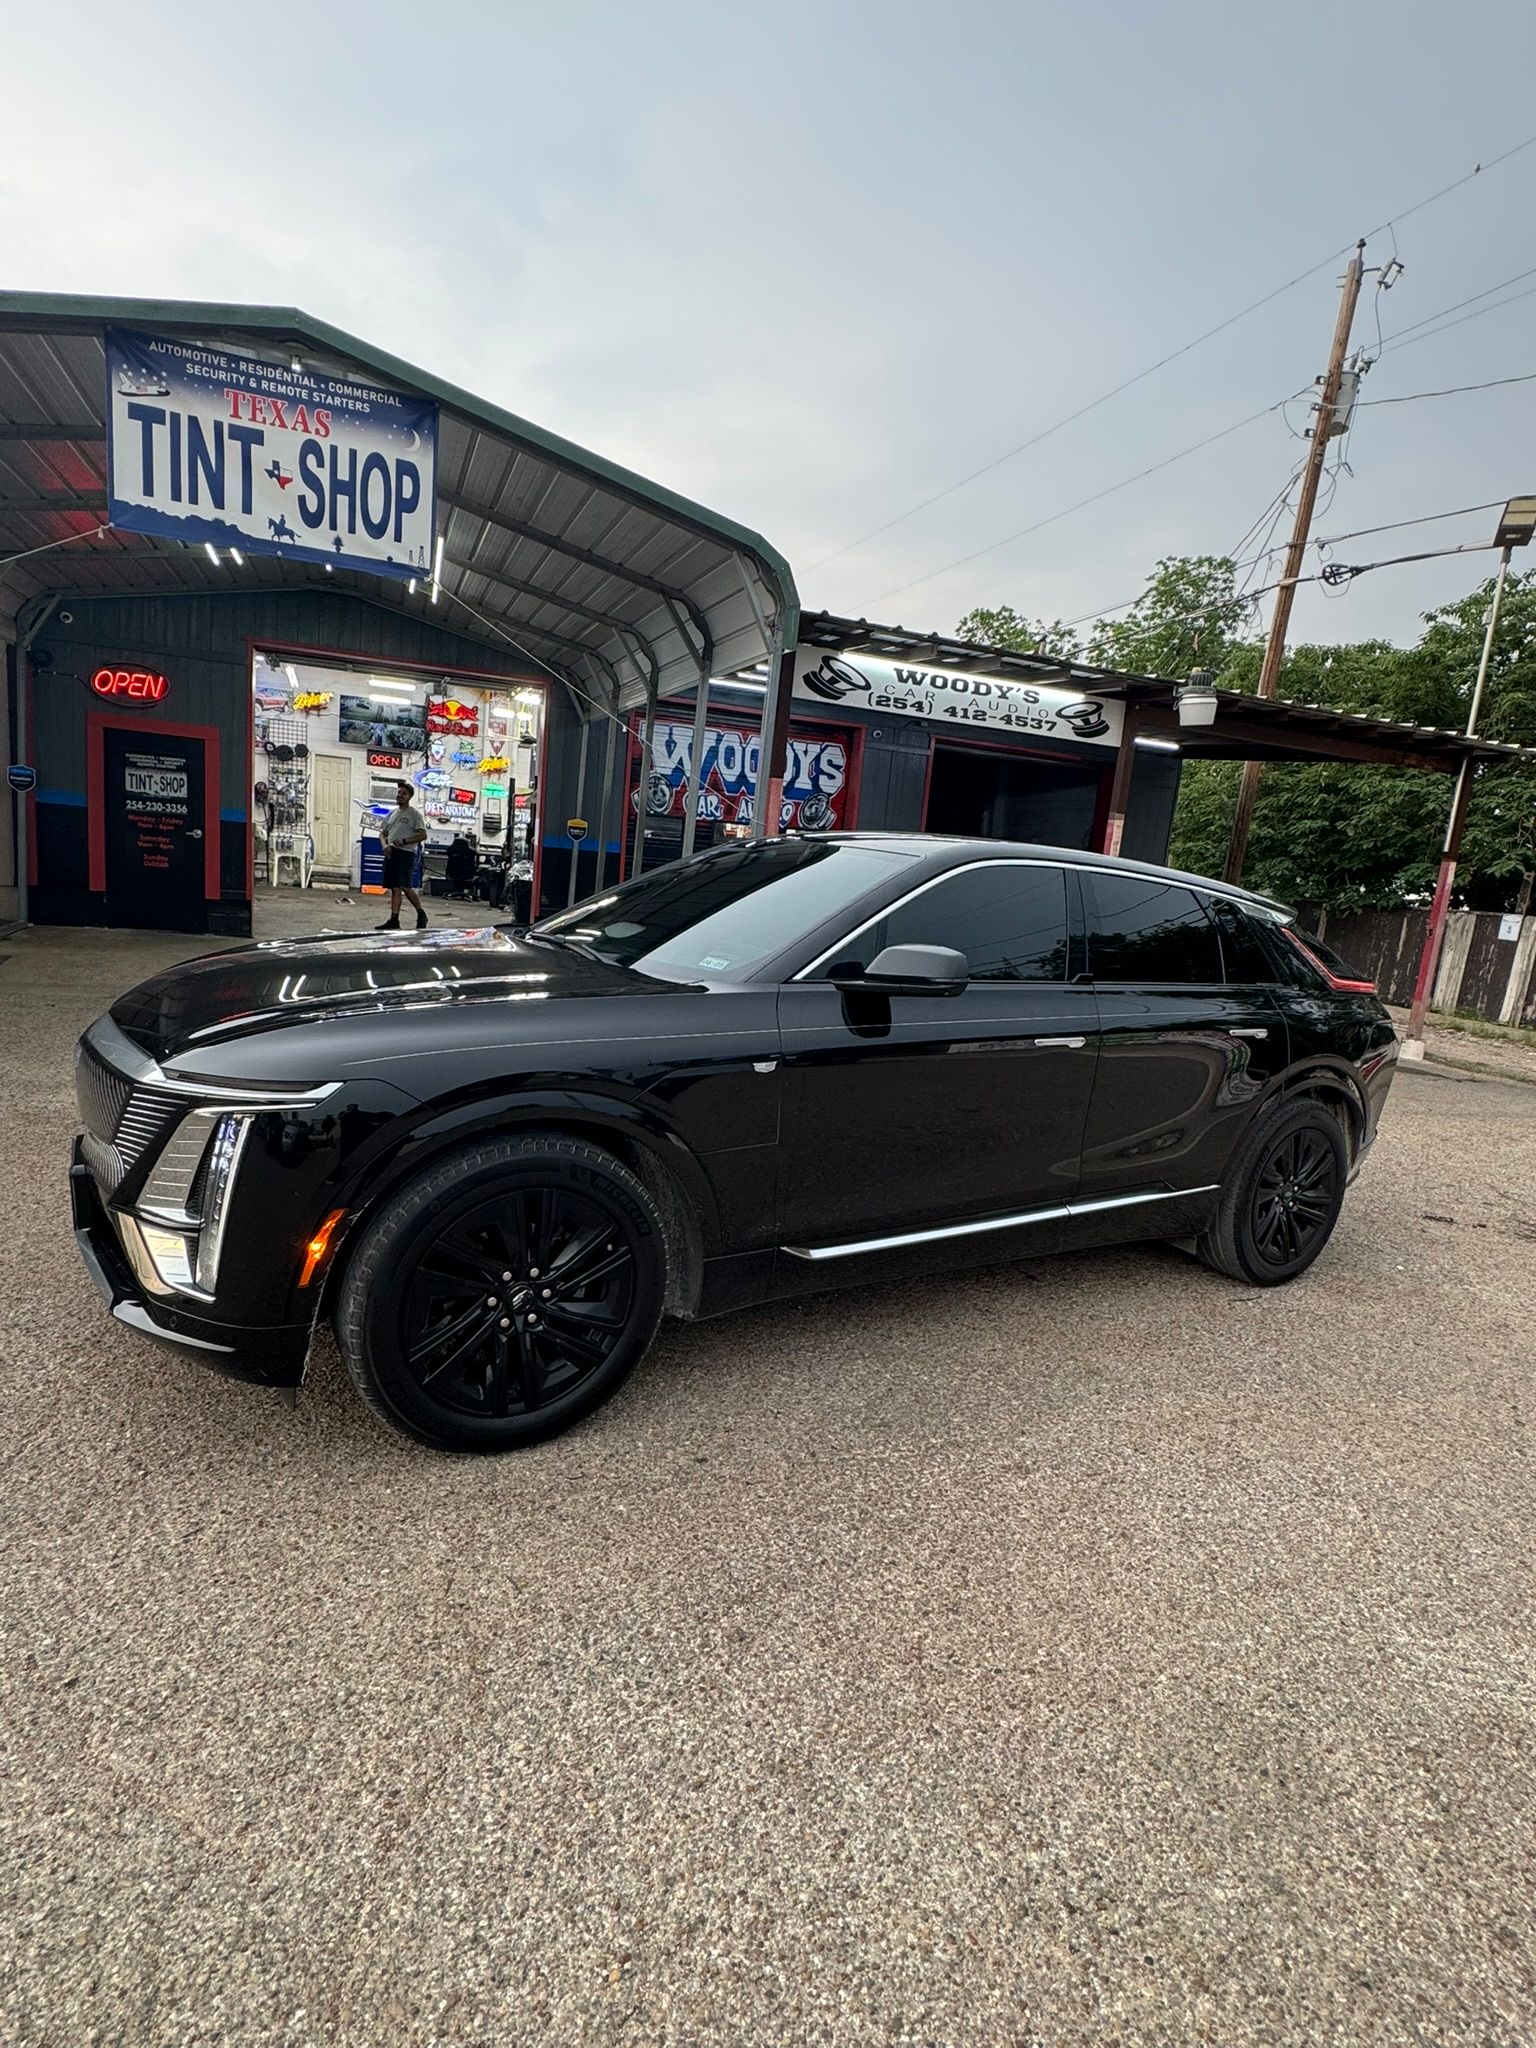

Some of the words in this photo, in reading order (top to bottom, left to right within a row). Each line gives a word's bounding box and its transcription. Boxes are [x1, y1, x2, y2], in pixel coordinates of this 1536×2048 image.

[149, 340, 228, 368] AUTOMOTIVE
[239, 361, 318, 388] RESIDENTIAL
[328, 382, 403, 407] COMMERCIAL
[185, 363, 246, 387] SECURITY
[249, 377, 257, 388] &
[260, 379, 310, 400] REMOTE
[312, 391, 371, 413] STARTERS
[224, 387, 332, 438] TEXAS
[127, 401, 265, 515] TINT
[297, 438, 421, 543] SHOP
[94, 669, 163, 698] OPEN
[884, 684, 936, 702] CAR
[968, 698, 1049, 718] AUDIO
[892, 667, 1040, 704] WOODY'S
[867, 692, 934, 715] (254)
[943, 706, 1057, 731] 412-4537
[370, 754, 400, 766] OPEN
[641, 723, 846, 794] WOOYS
[127, 773, 154, 791] TINT
[159, 775, 185, 794] SHOP
[125, 799, 188, 814] 254-230-3356
[685, 795, 723, 818] AR
